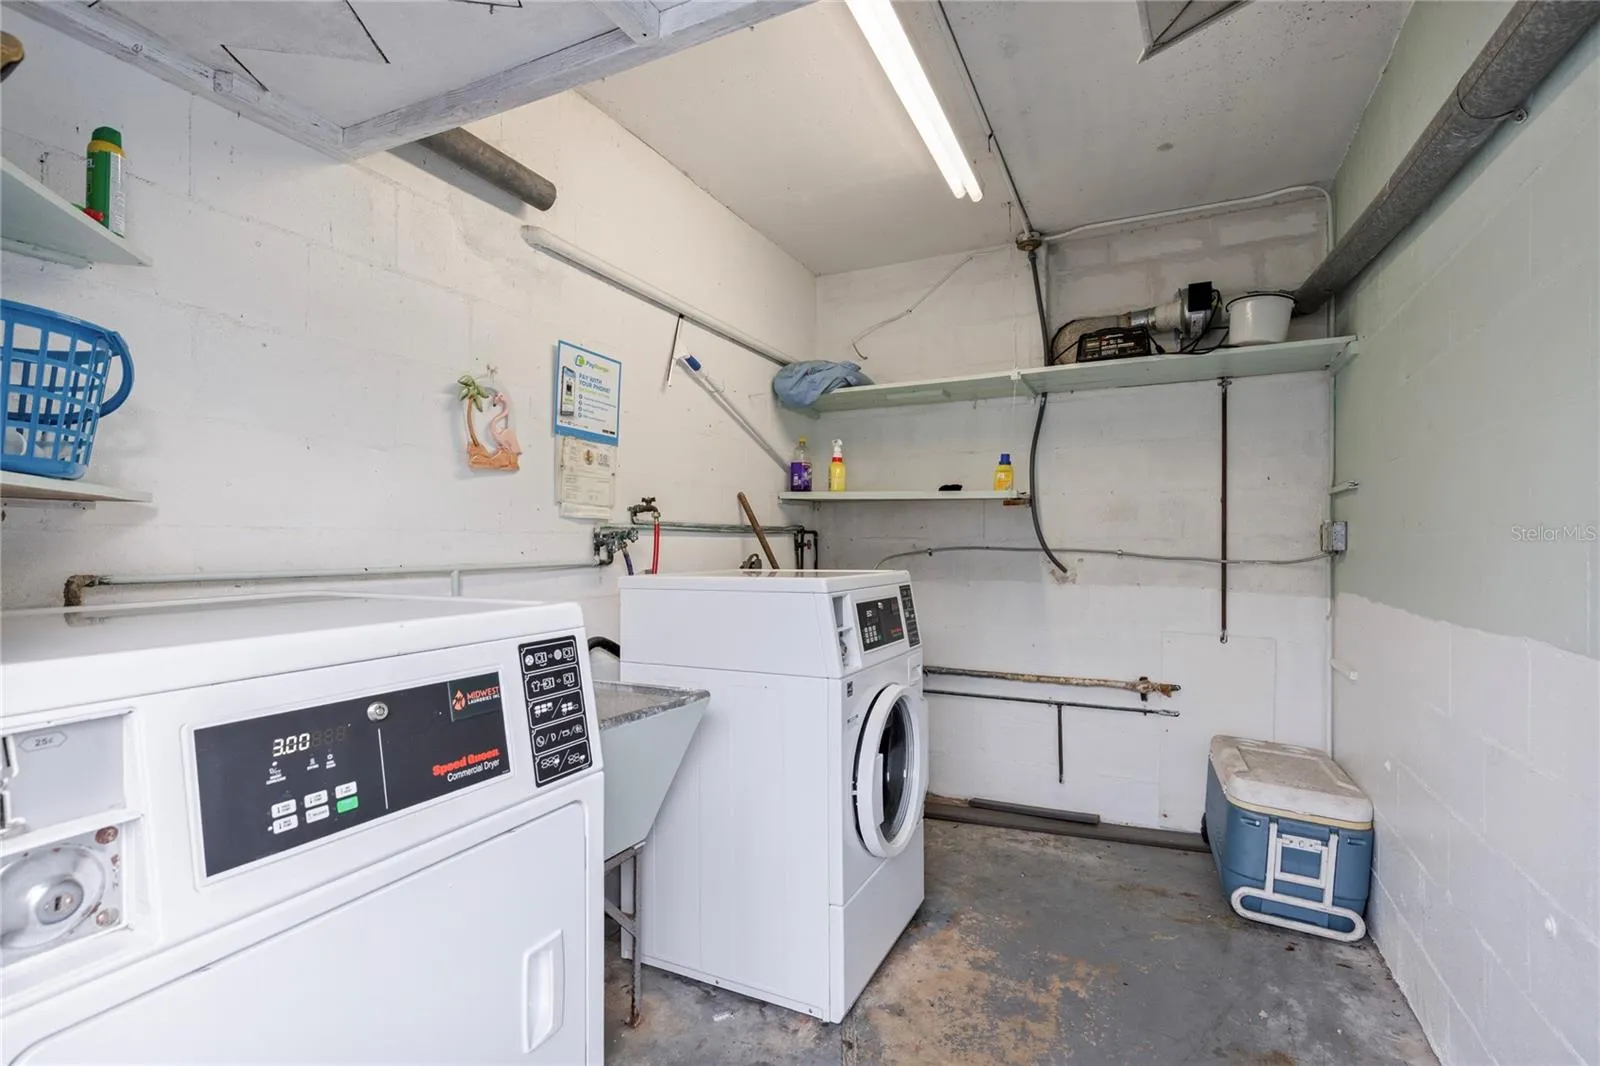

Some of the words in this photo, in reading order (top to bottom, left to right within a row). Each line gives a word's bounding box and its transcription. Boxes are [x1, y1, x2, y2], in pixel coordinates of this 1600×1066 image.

[579, 373, 589, 381] PAY
[590, 376, 602, 384] WITH
[580, 380, 592, 388] YOUR
[467, 687, 500, 699] MIDWEST
[273, 733, 311, 757] 3.00
[433, 756, 468, 777] Speed
[447, 763, 484, 782] Commercial
[483, 758, 501, 771] Dryer
